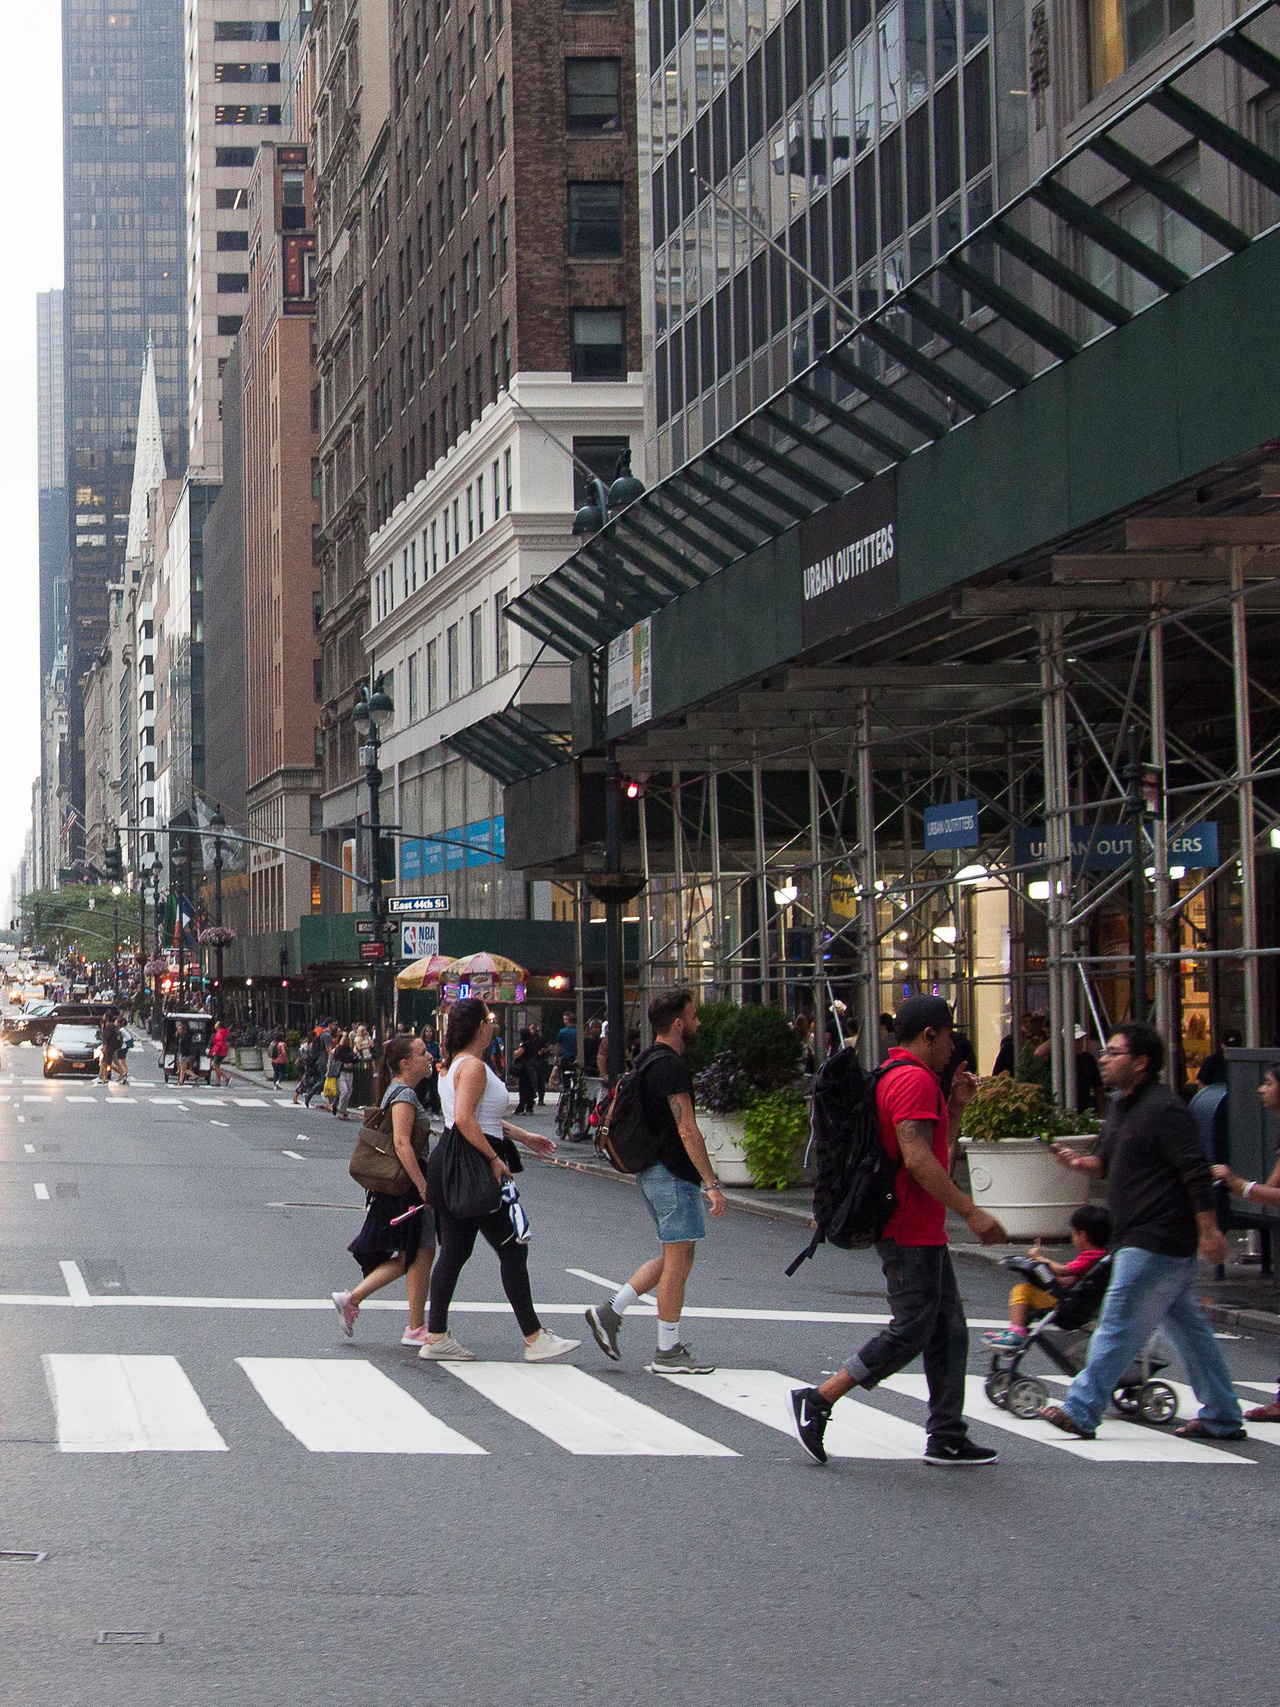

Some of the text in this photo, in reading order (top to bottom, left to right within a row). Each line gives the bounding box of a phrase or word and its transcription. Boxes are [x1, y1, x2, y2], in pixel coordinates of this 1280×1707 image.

[803, 523, 895, 601] URBAN OUTFITTERS
[1030, 837, 1203, 858] UAN OUTERS
[392, 898, 445, 910] East 44th St
[418, 925, 436, 940] NBA
[418, 940, 438, 955] Store
